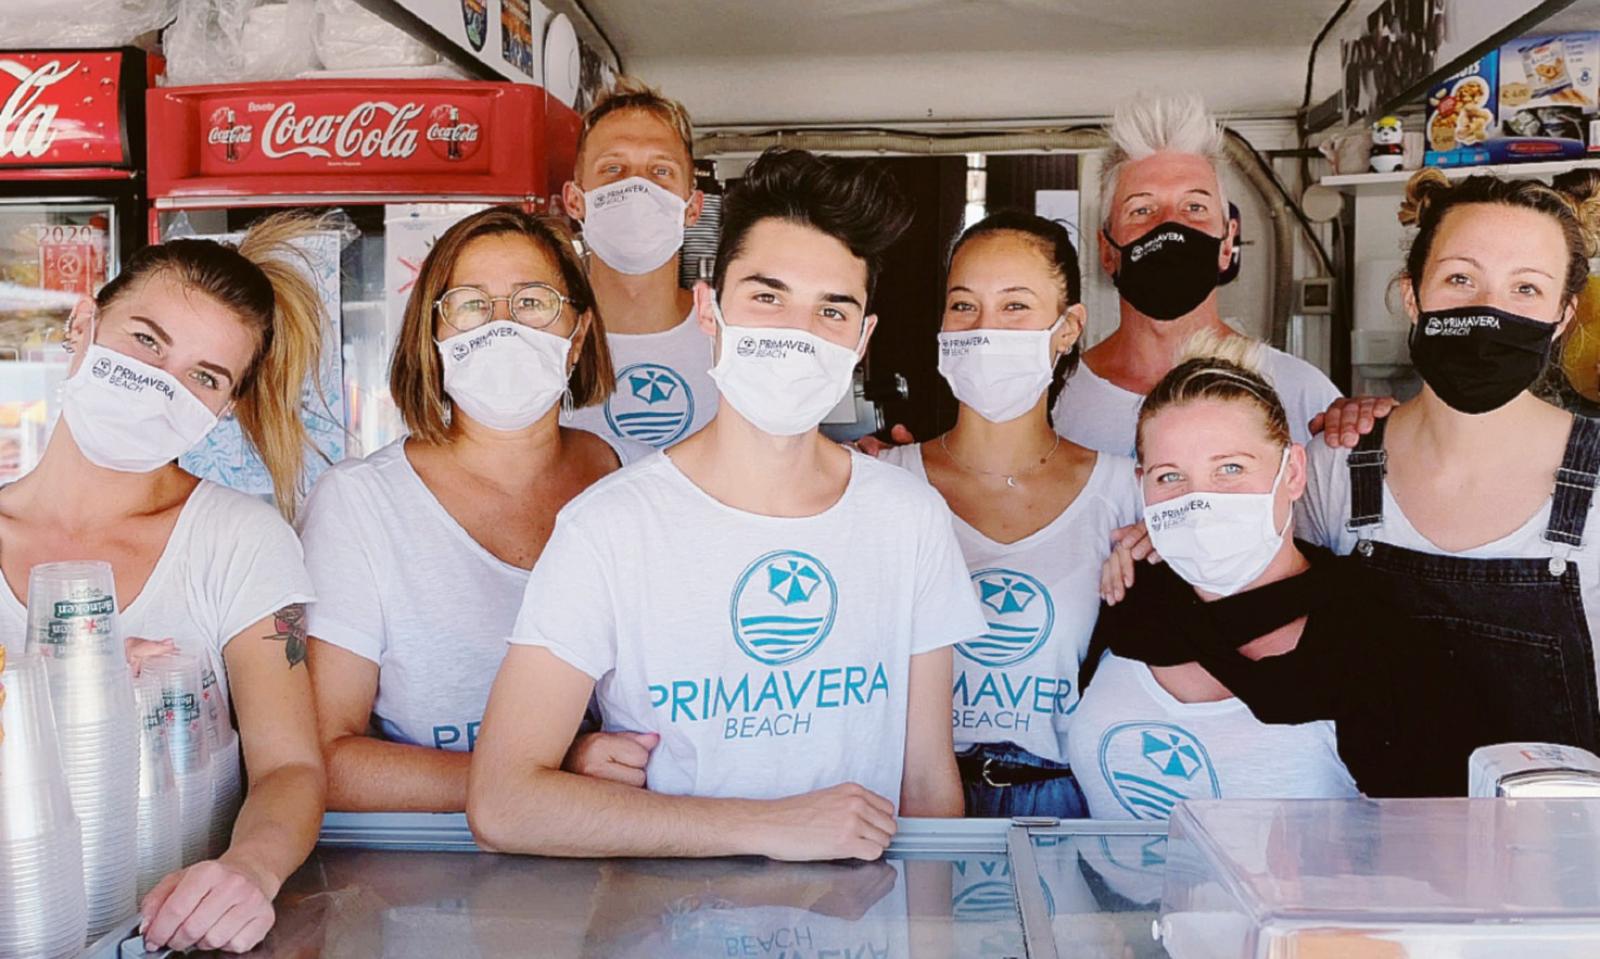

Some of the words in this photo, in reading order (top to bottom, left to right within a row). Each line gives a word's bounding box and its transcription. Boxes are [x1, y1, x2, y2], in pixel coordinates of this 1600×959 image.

[208, 125, 252, 144] Coca-Cola
[261, 101, 425, 158] Coca-Cola
[426, 122, 479, 141] Coca-Cola
[40, 226, 92, 243] 2020
[1443, 315, 1500, 329] PRIMAVERA
[759, 339, 816, 356] PRIMAVERA
[109, 375, 144, 392] BEACH
[113, 364, 175, 400] PRIMAVERA
[648, 661, 889, 722] PRIMAVERA
[724, 712, 812, 739] BEACH
[953, 709, 1030, 732] BEACH
